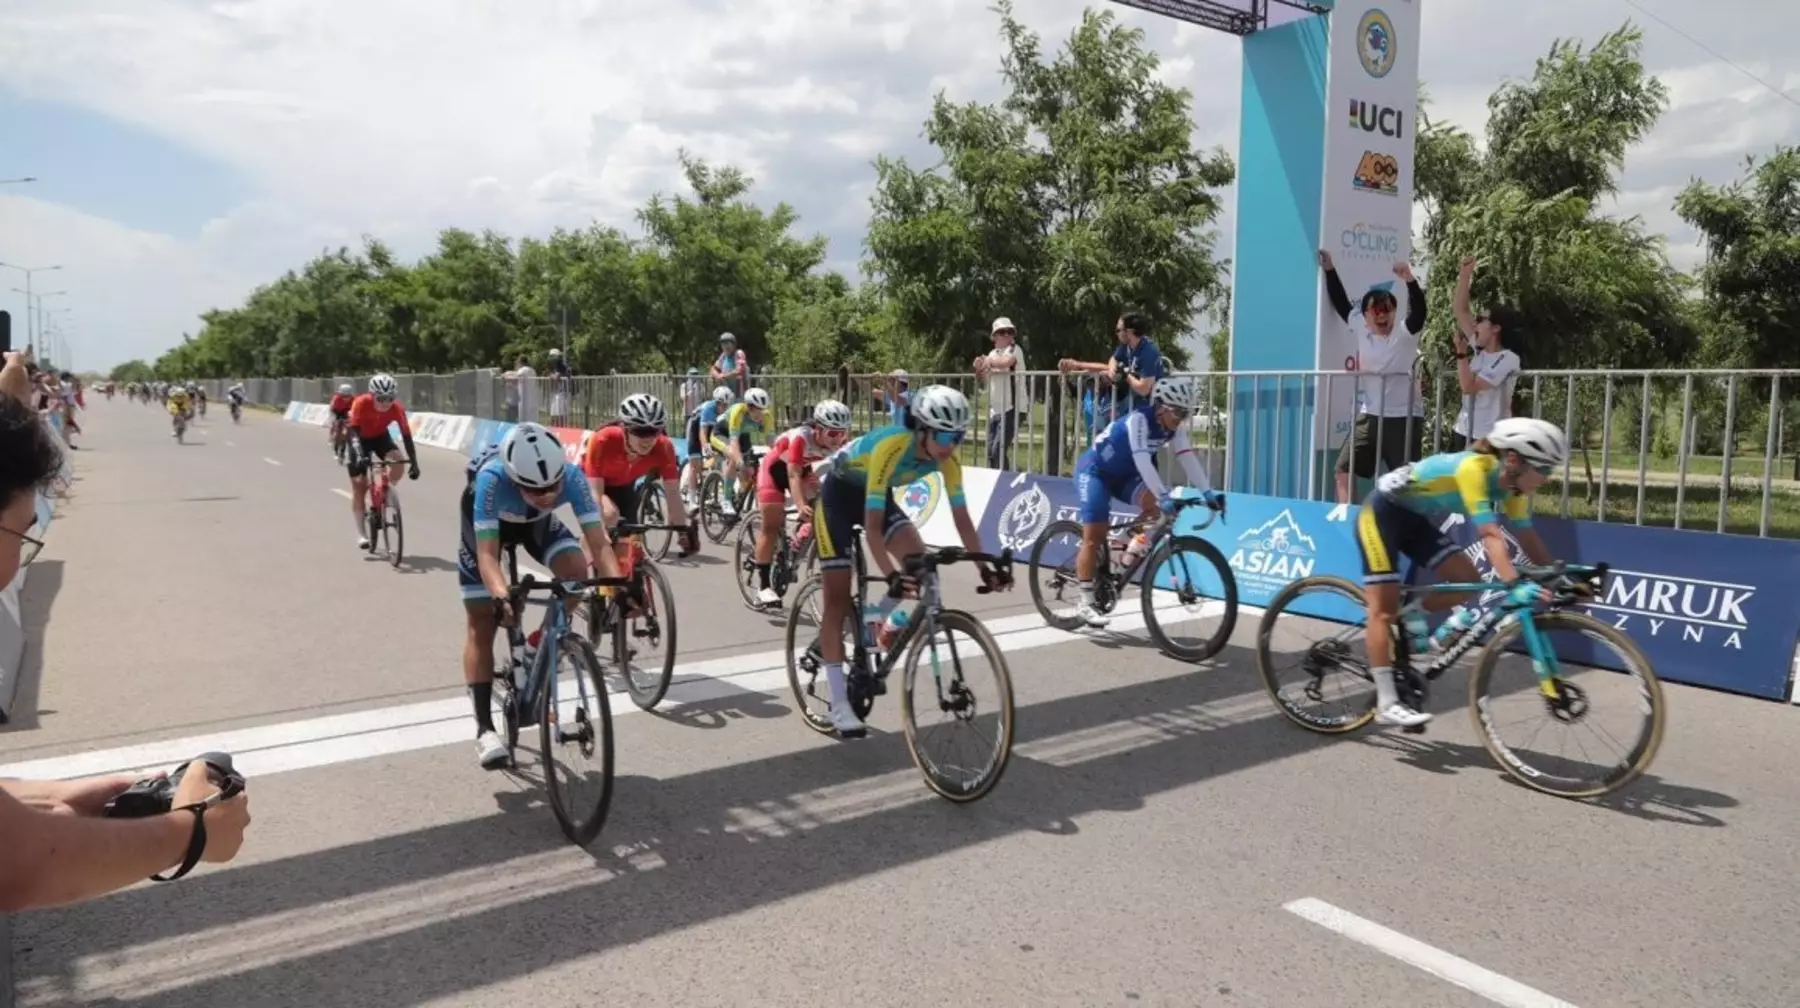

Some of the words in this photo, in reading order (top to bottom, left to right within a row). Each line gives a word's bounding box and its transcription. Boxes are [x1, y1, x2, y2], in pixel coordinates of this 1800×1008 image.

[1359, 101, 1402, 138] UCI
[1341, 227, 1398, 254] CYCLING
[1228, 548, 1316, 579] ASIAN
